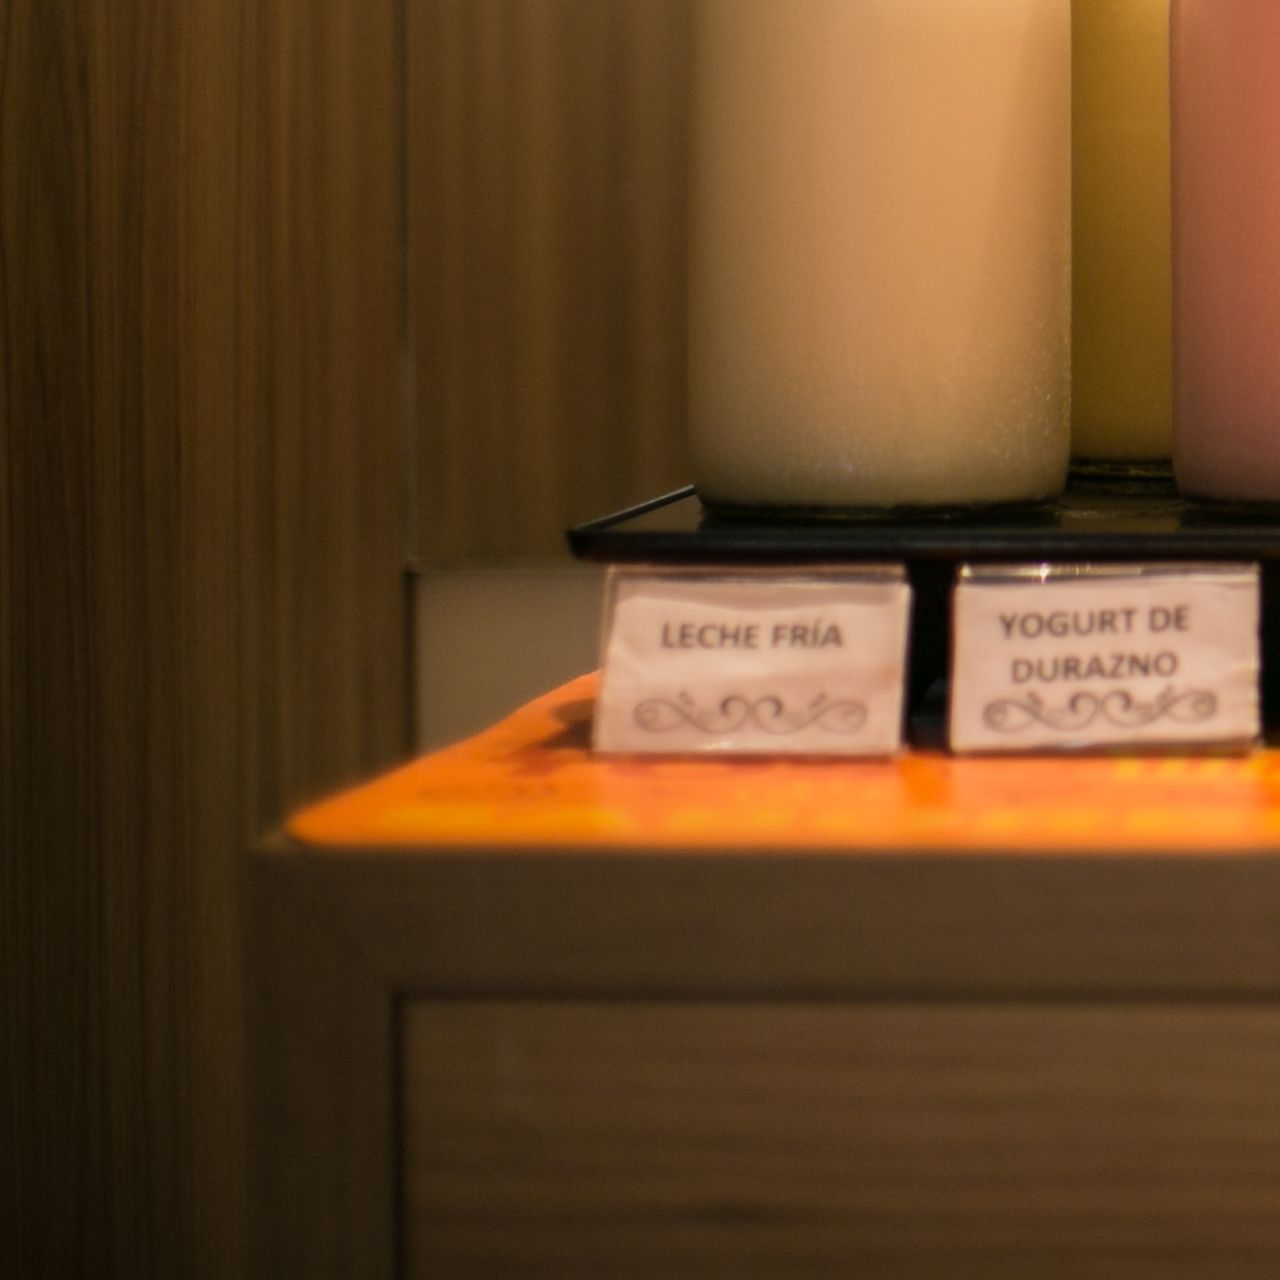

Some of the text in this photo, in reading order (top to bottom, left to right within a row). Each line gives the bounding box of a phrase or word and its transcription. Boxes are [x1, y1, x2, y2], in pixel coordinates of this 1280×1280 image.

[661, 616, 844, 650] LECHE FRÍA
[999, 605, 1190, 639] YOGURT DE
[1011, 651, 1180, 684] DURAZNO
